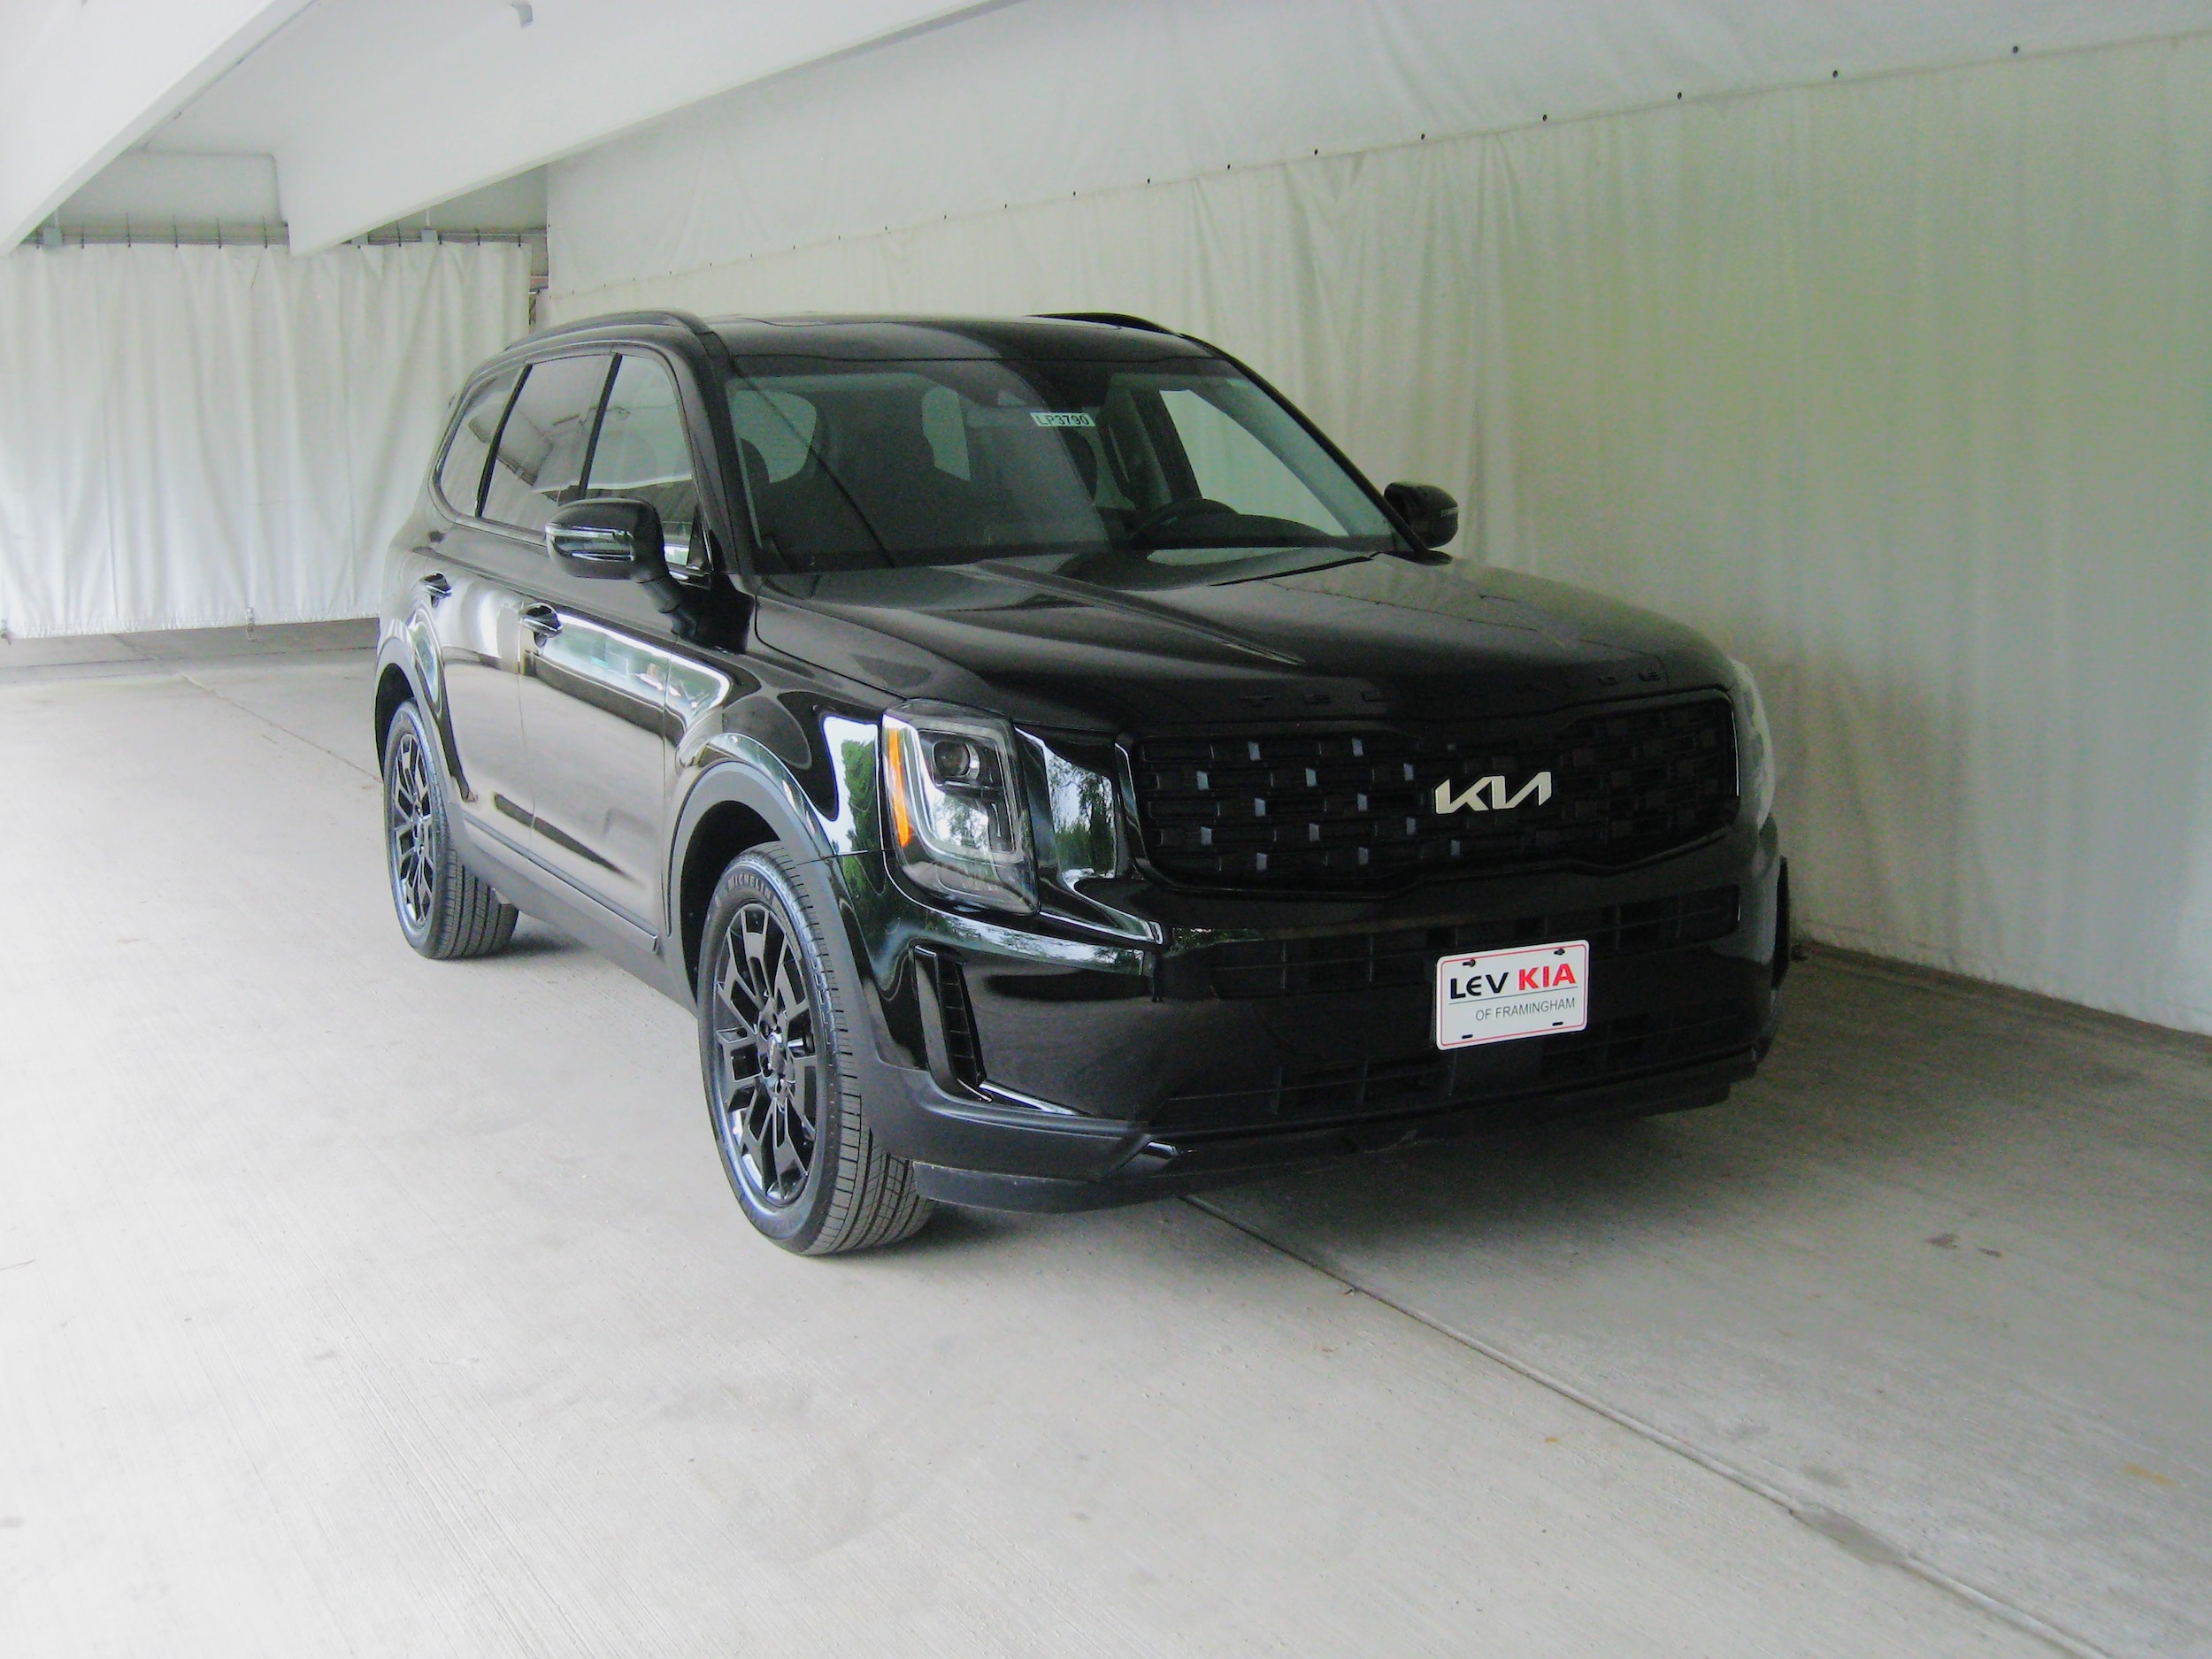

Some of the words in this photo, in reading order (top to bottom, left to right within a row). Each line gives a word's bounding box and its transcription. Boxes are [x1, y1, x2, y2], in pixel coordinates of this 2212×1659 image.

[1035, 415, 1090, 426] LP3790
[1435, 771, 1552, 814] KIA
[1450, 972, 1509, 999] LEV
[1518, 963, 1577, 990] KIA
[1475, 1008, 1492, 1021] OF
[1495, 997, 1575, 1018] FRAMINGHAM
